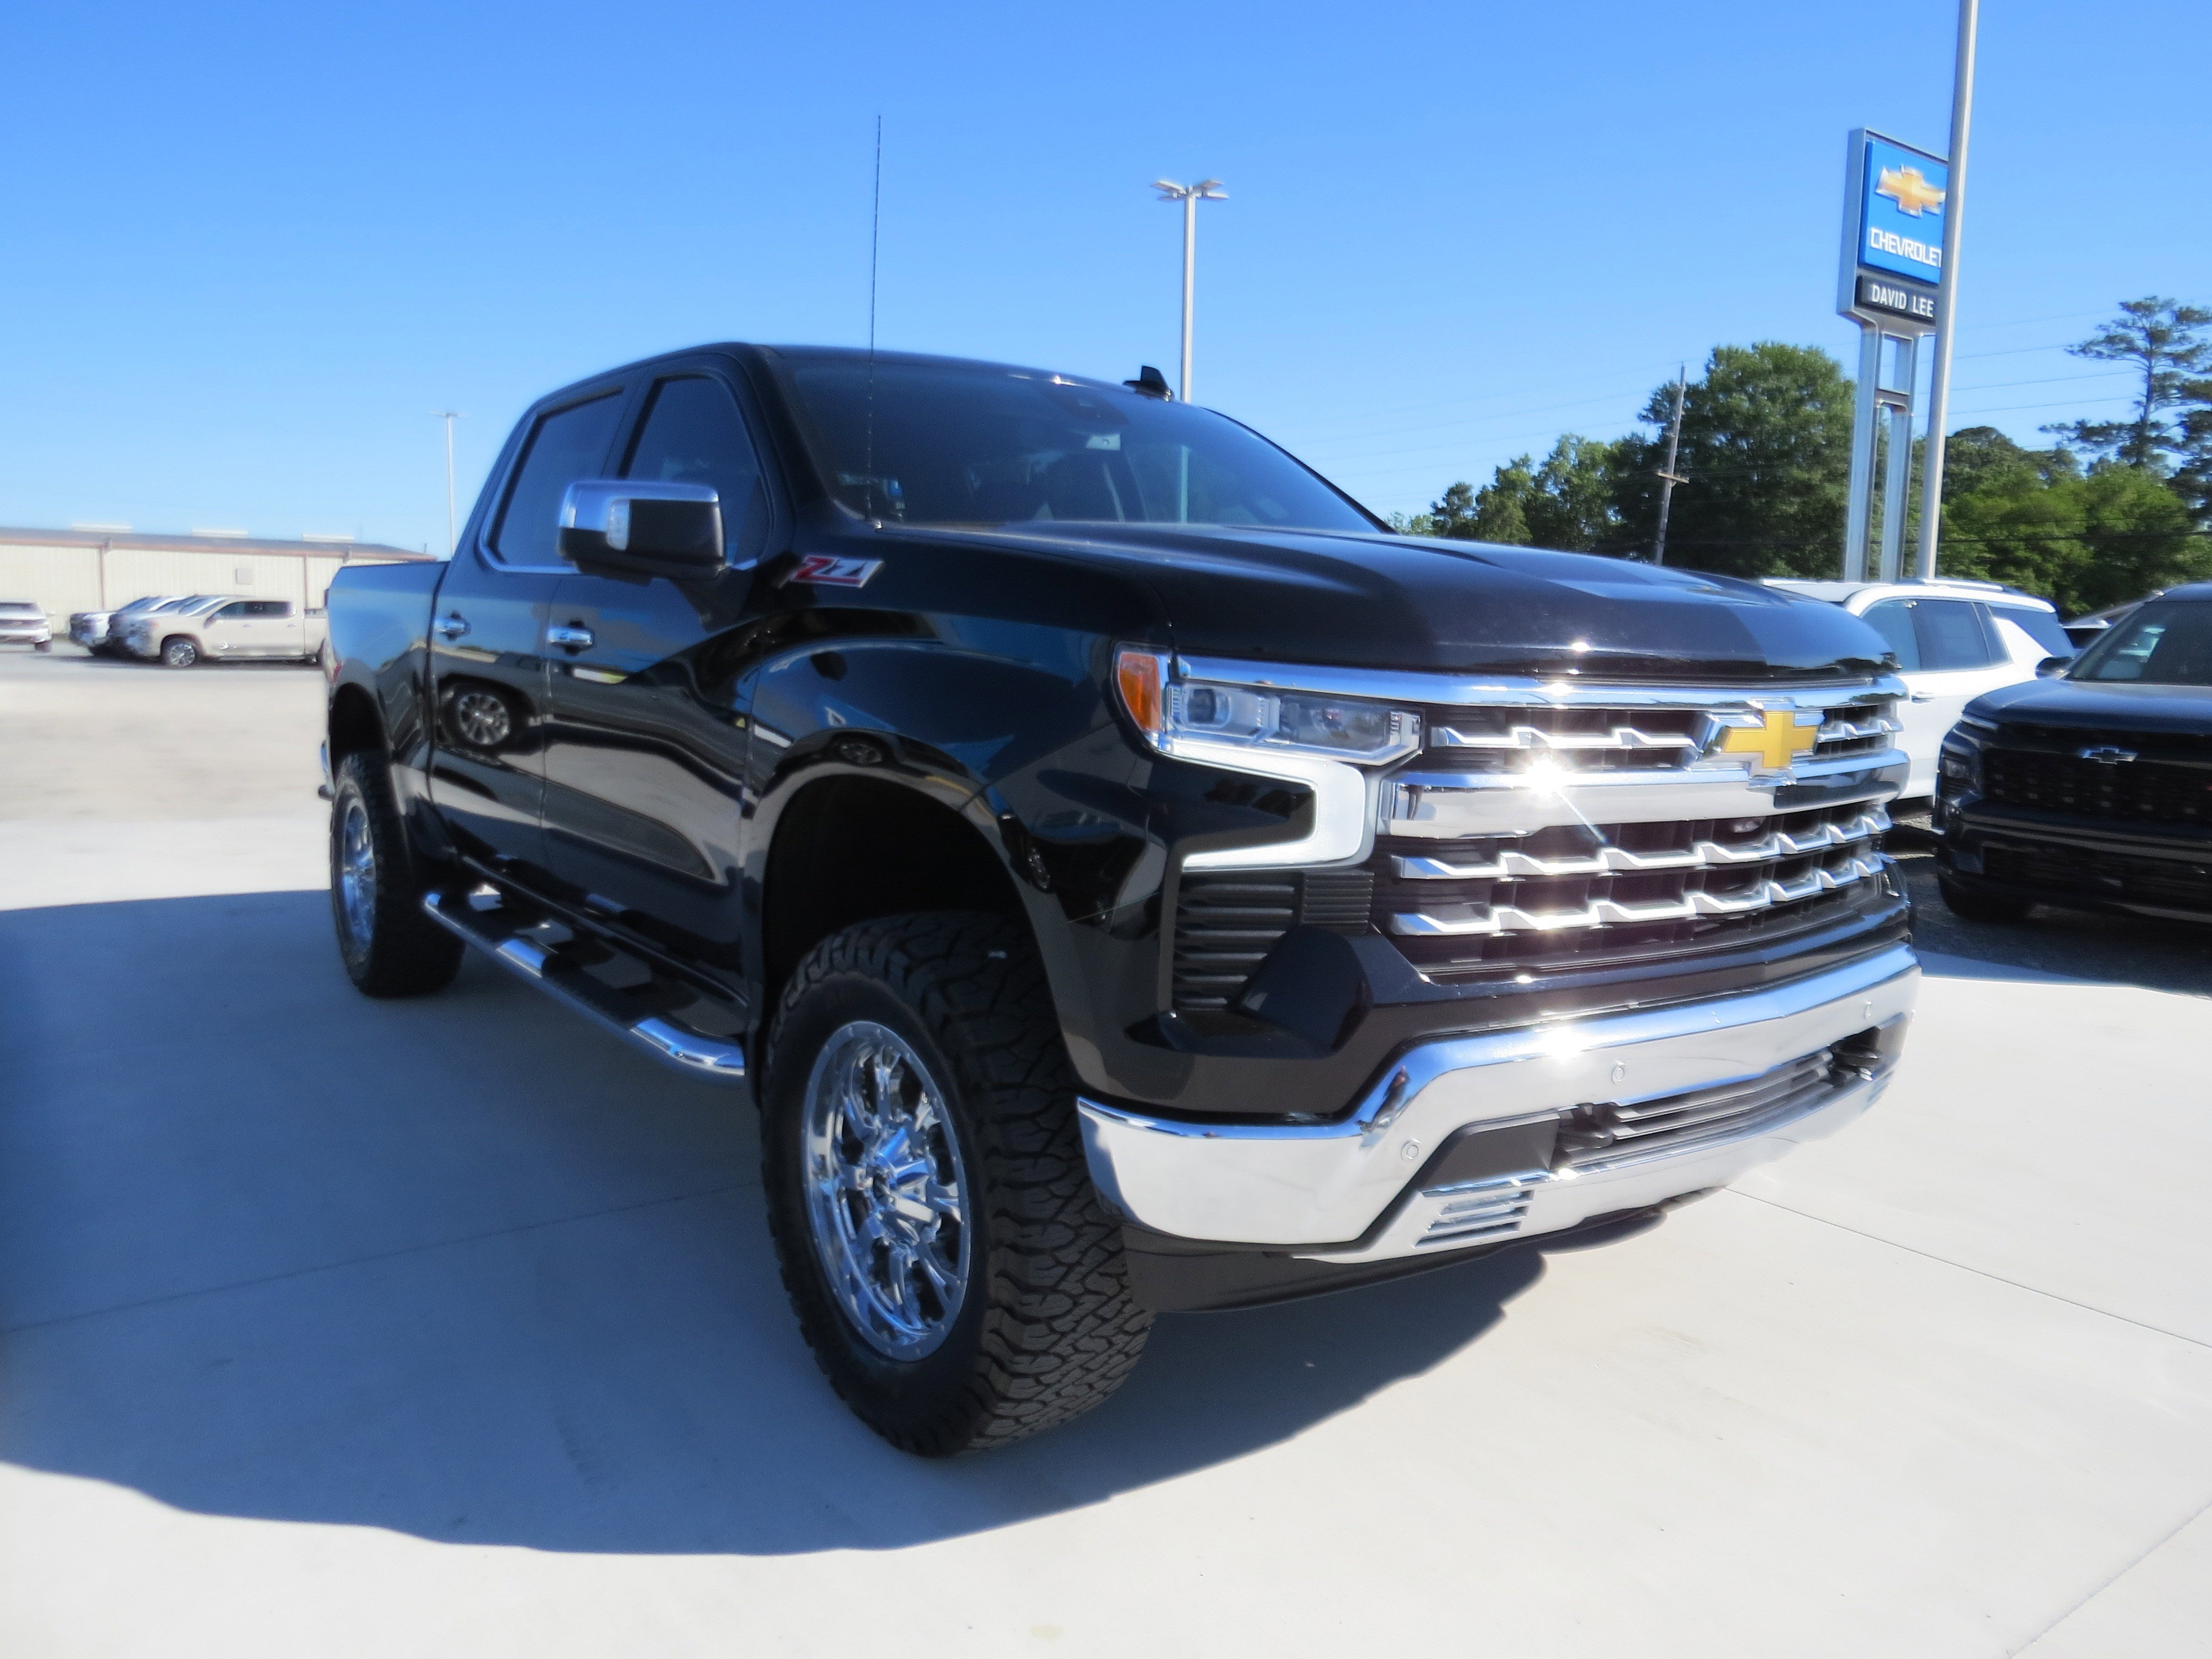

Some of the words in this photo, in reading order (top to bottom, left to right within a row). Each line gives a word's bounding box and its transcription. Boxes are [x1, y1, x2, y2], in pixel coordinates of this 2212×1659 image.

[1871, 227, 1942, 268] CHEVROLET
[1871, 284, 1907, 310] DAVID
[1913, 295, 1934, 318] LEE
[790, 555, 884, 588] Z71
